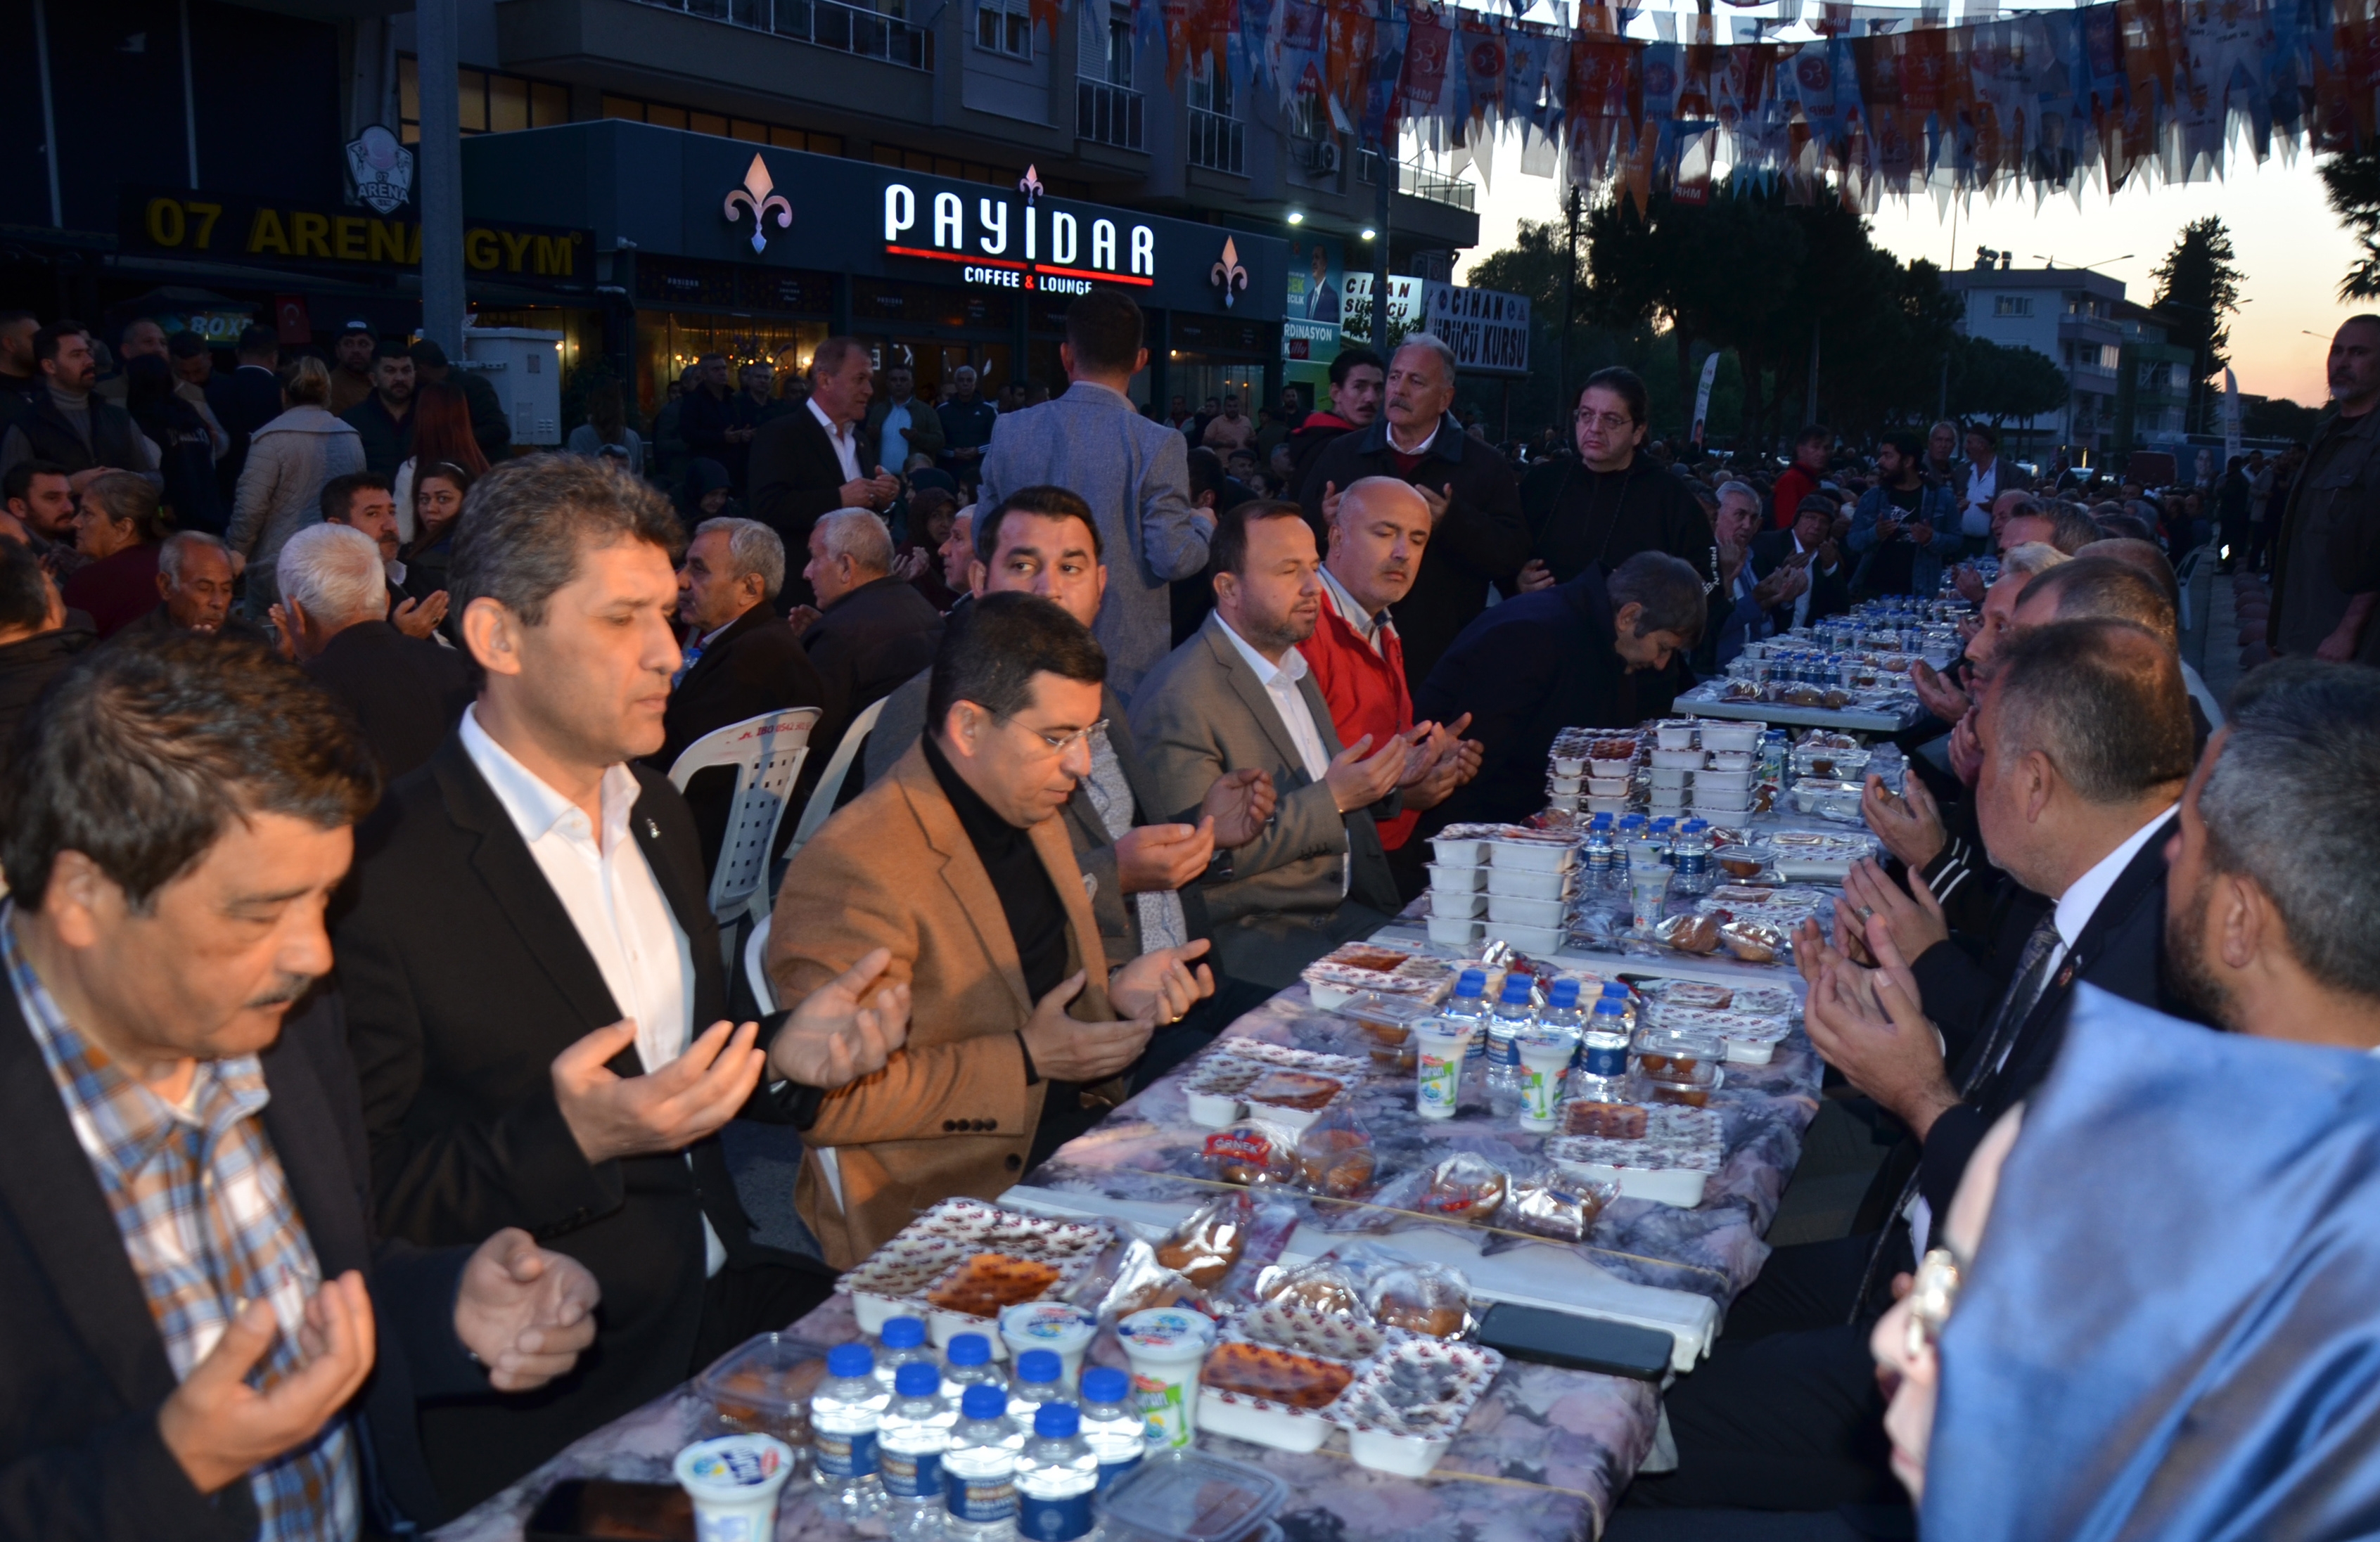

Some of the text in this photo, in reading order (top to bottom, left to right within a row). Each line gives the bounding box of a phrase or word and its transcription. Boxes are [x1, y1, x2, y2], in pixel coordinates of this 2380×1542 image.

[376, 172, 389, 182] 07
[357, 181, 410, 205] ARENA
[146, 196, 222, 250] 07
[465, 228, 574, 276] GYM
[964, 266, 1019, 288] COFFEE
[1024, 275, 1035, 289] &
[1452, 288, 1504, 321] CİHAN
[1291, 340, 1307, 358] illy
[1482, 325, 1527, 368] KURSU
[1214, 1137, 1259, 1155] ÖRNEK
